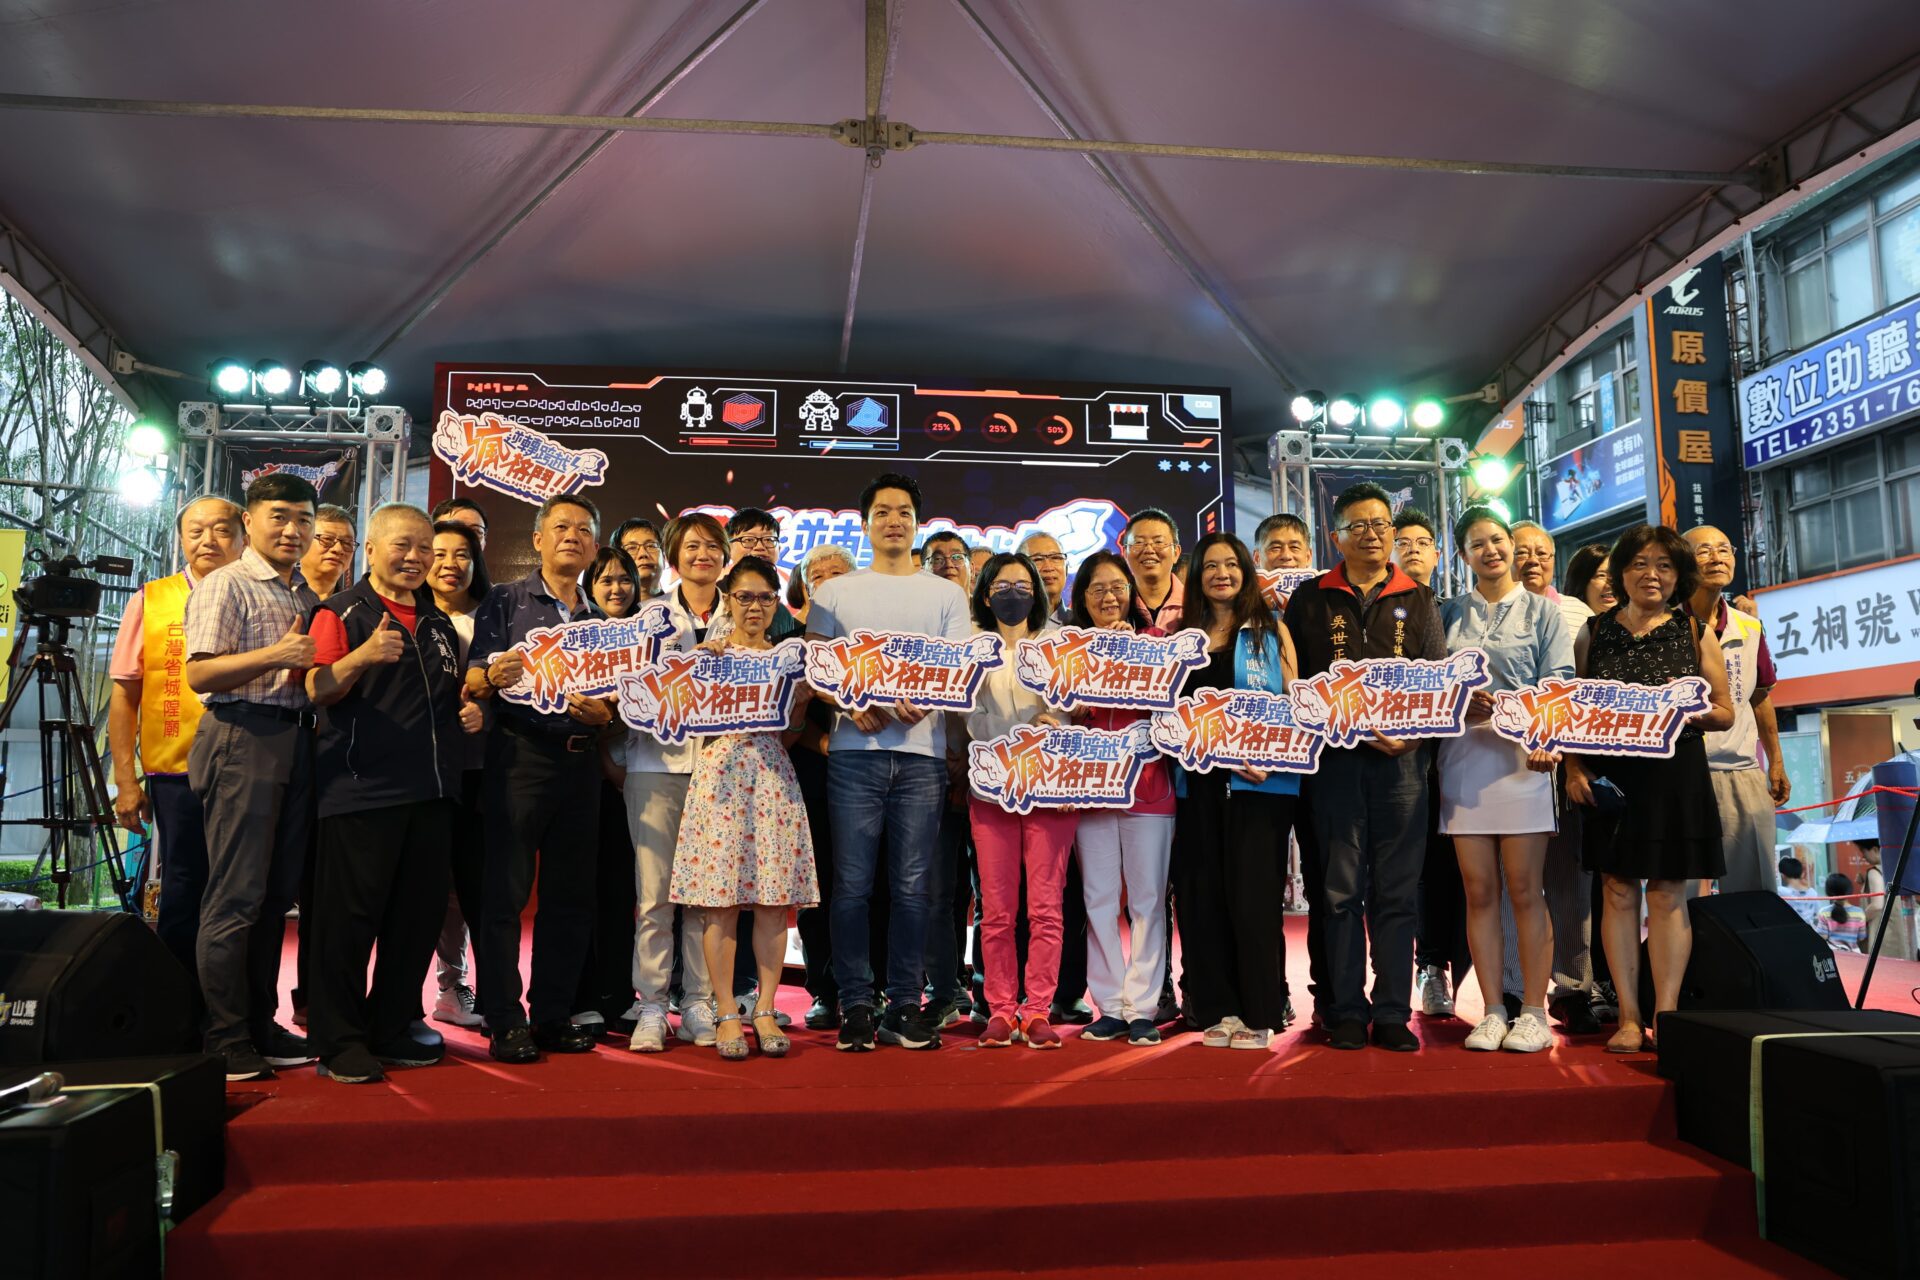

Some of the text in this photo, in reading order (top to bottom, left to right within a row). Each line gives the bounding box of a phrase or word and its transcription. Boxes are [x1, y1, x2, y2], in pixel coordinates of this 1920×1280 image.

[1663, 306, 1704, 316] AORUS
[1670, 330, 1715, 465] 原價屋
[932, 423, 950, 431] 25%
[989, 424, 1007, 433] 25%
[1047, 426, 1064, 434] 50%
[504, 430, 568, 474] 逆轉跨越
[562, 625, 640, 651] 逆轉跨越
[1330, 615, 1349, 662] 吳世正
[1393, 620, 1405, 659] 台北市議
[1774, 592, 1901, 659] 五桐號
[882, 637, 963, 668] 逆轉跨越
[1088, 635, 1166, 666] 逆轉跨越
[163, 621, 184, 738] 台灣省城隍廟
[692, 655, 773, 685] 逆轉跨越
[1364, 664, 1450, 691] 逆轉跨越
[1571, 684, 1662, 713] 逆轉跨越
[1042, 732, 1121, 761] 逆轉跨越
